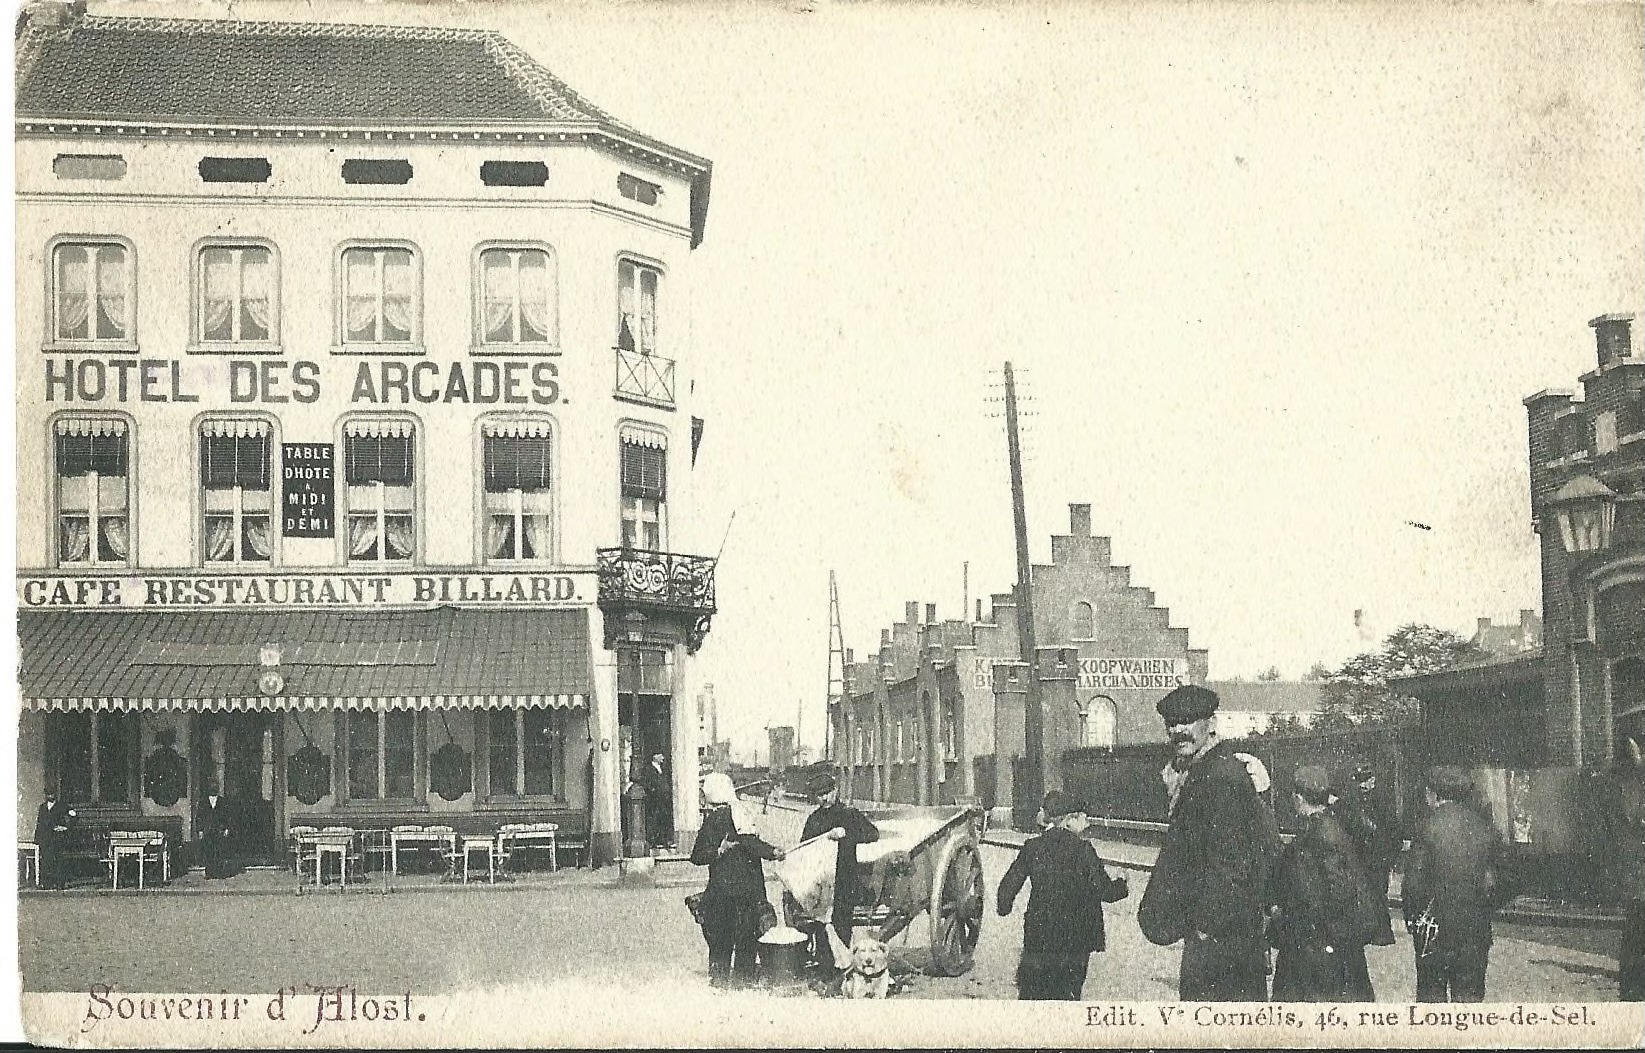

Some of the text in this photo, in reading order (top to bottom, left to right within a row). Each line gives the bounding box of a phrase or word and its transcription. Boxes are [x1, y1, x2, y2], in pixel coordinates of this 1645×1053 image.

[44, 359, 569, 405] HOTEL DES ARCADES.
[285, 447, 330, 460] TABLE
[301, 507, 314, 516] ET
[144, 578, 392, 606] RESTAURANT
[412, 577, 583, 604] BILLARD.
